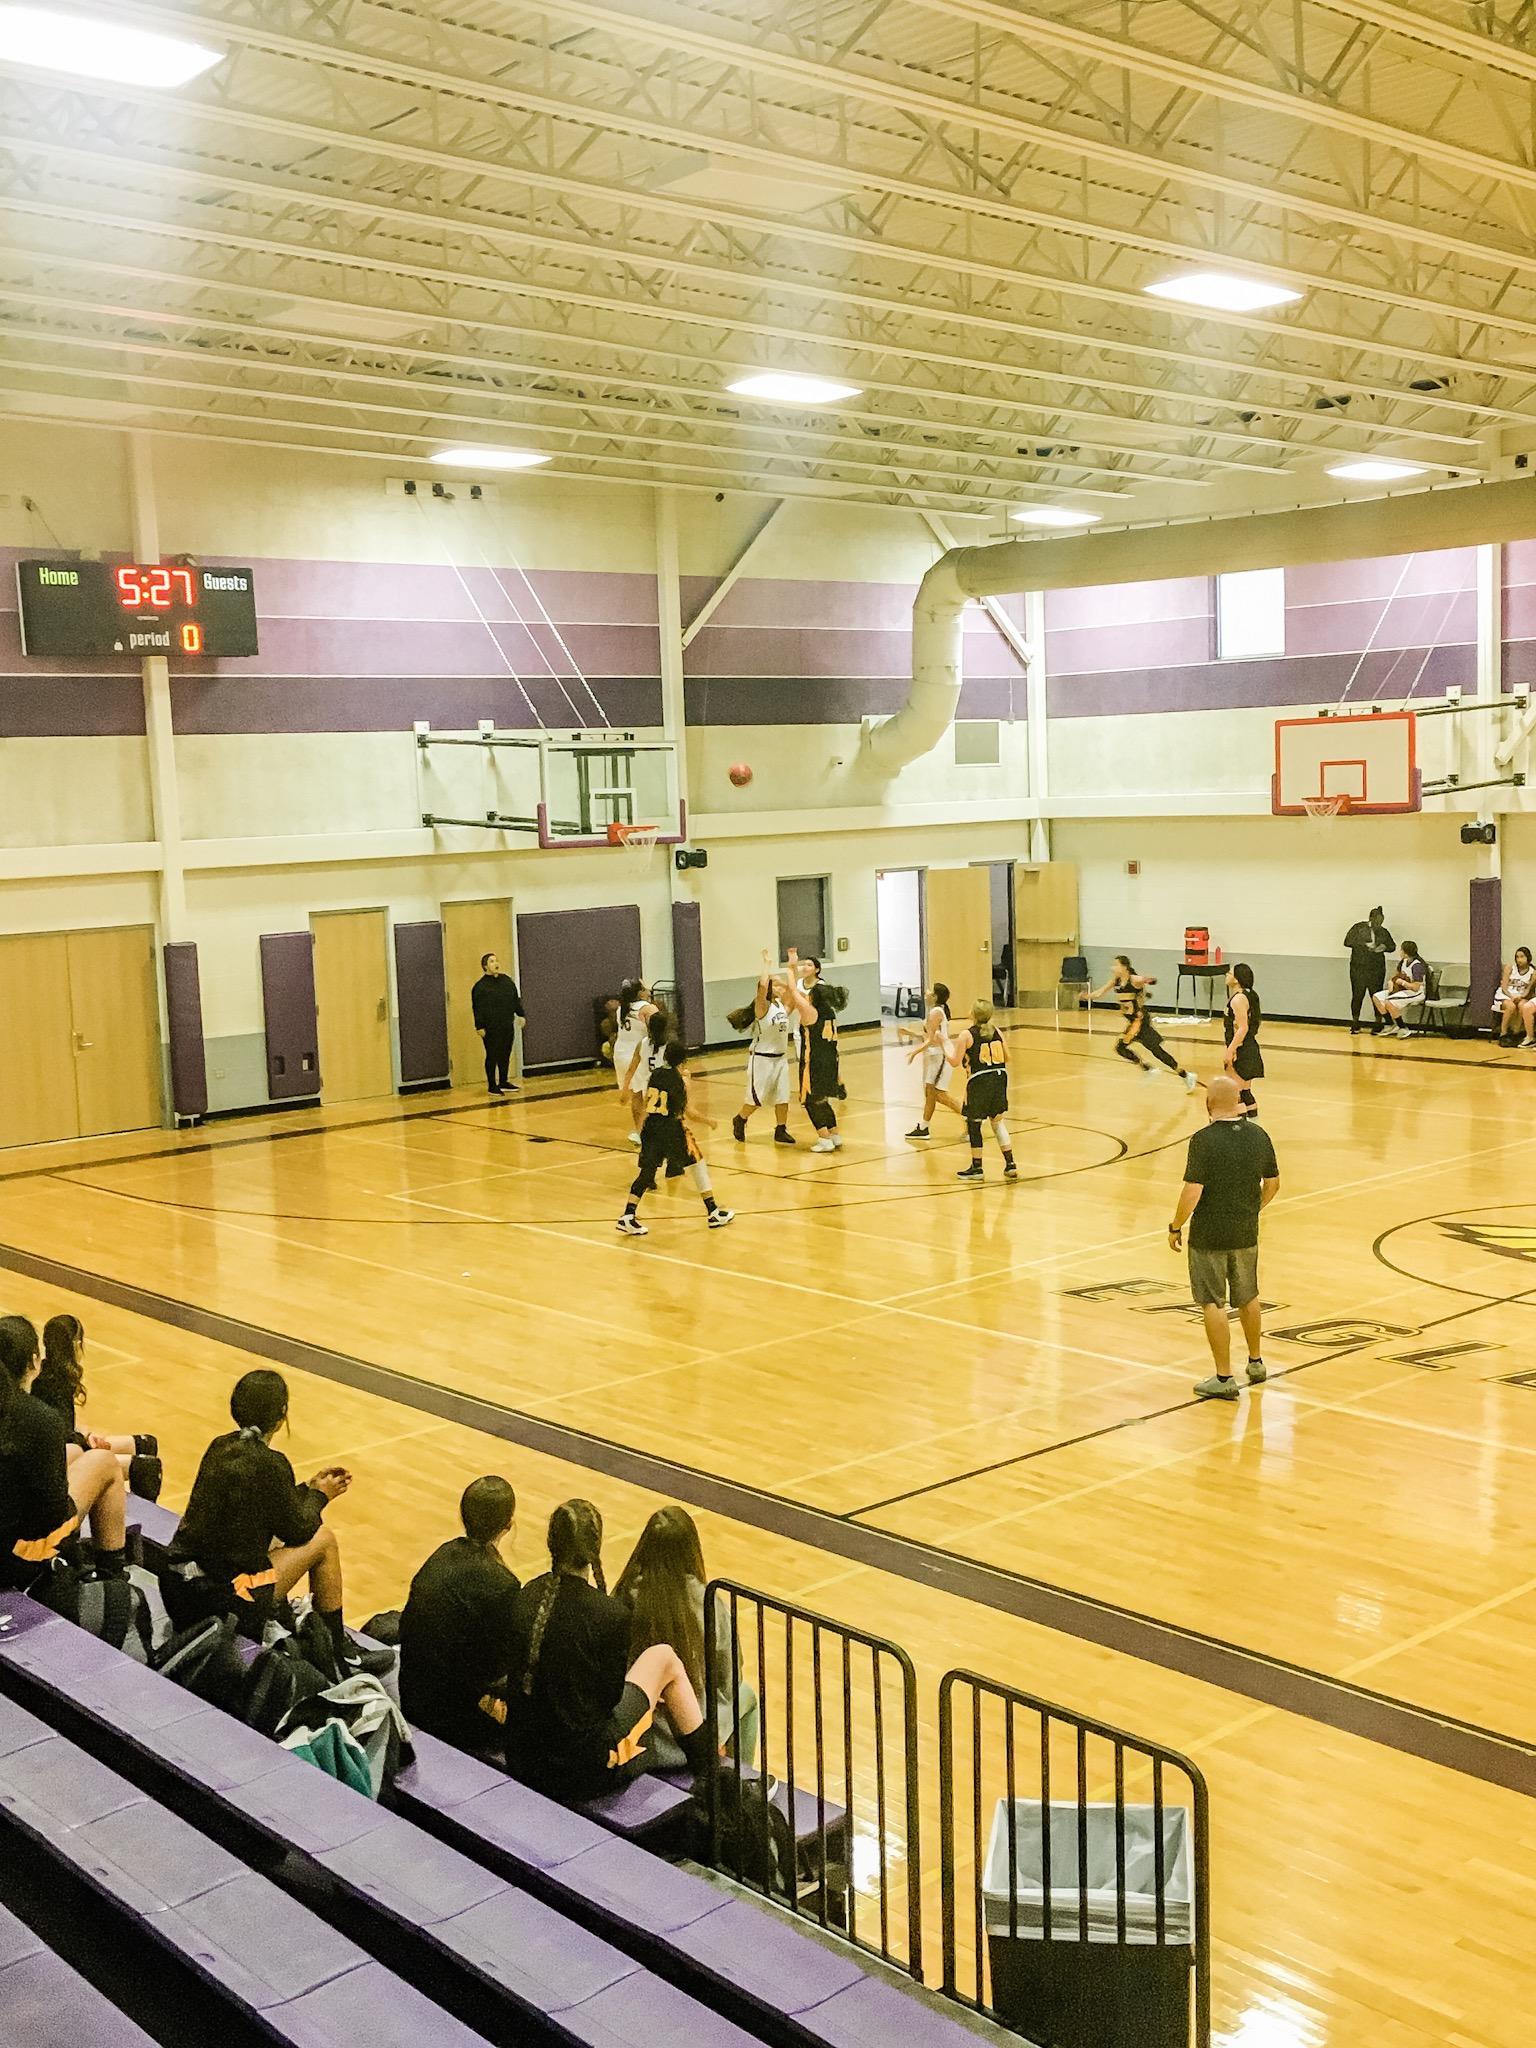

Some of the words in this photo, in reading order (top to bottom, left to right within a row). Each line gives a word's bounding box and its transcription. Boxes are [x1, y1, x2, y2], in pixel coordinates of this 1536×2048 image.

[39, 567, 79, 585] Home
[117, 568, 193, 606] 5:27
[203, 572, 248, 591] Guests
[129, 631, 170, 649] period
[182, 624, 200, 651] 0
[979, 1040, 1005, 1066] 40
[645, 1086, 669, 1116] 21
